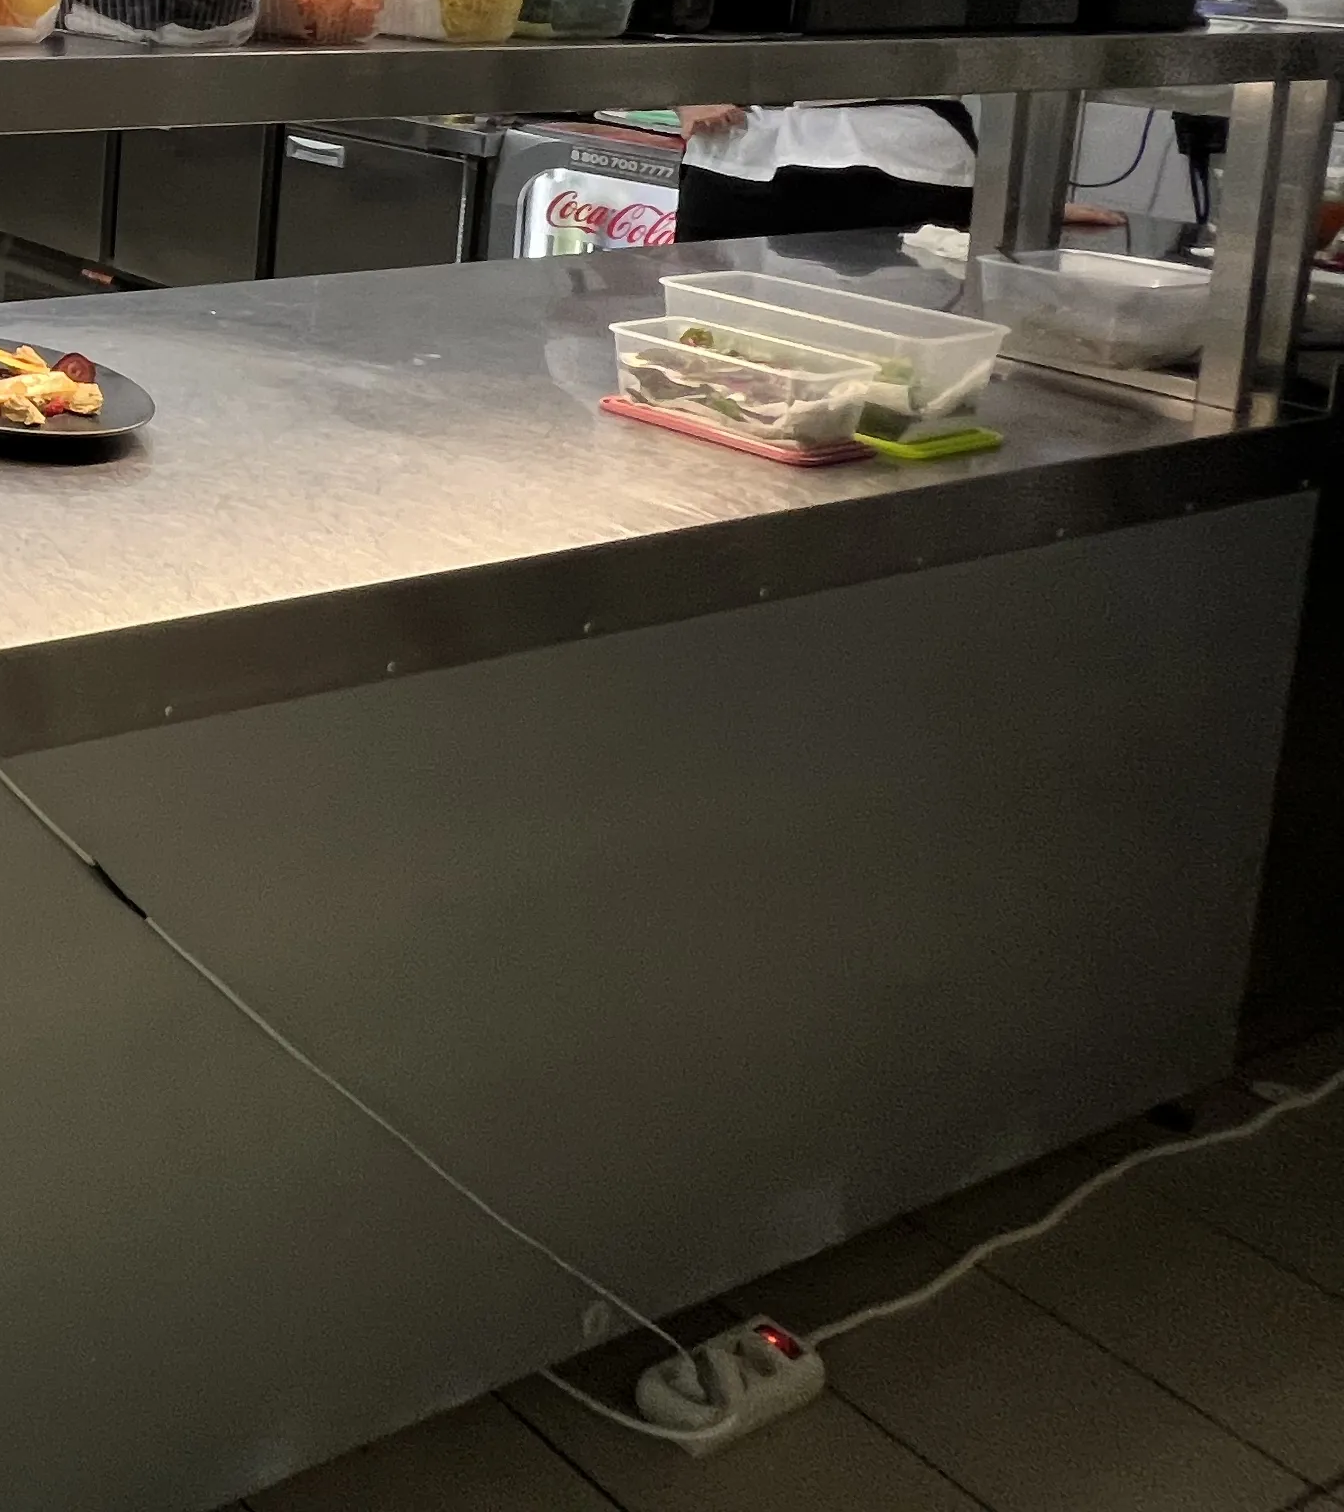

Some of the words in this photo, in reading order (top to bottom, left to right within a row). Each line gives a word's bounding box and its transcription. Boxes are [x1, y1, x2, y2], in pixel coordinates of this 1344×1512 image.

[570, 149, 580, 161] 8
[581, 151, 609, 166] 800
[610, 157, 638, 171] 700
[640, 162, 675, 178] 7777
